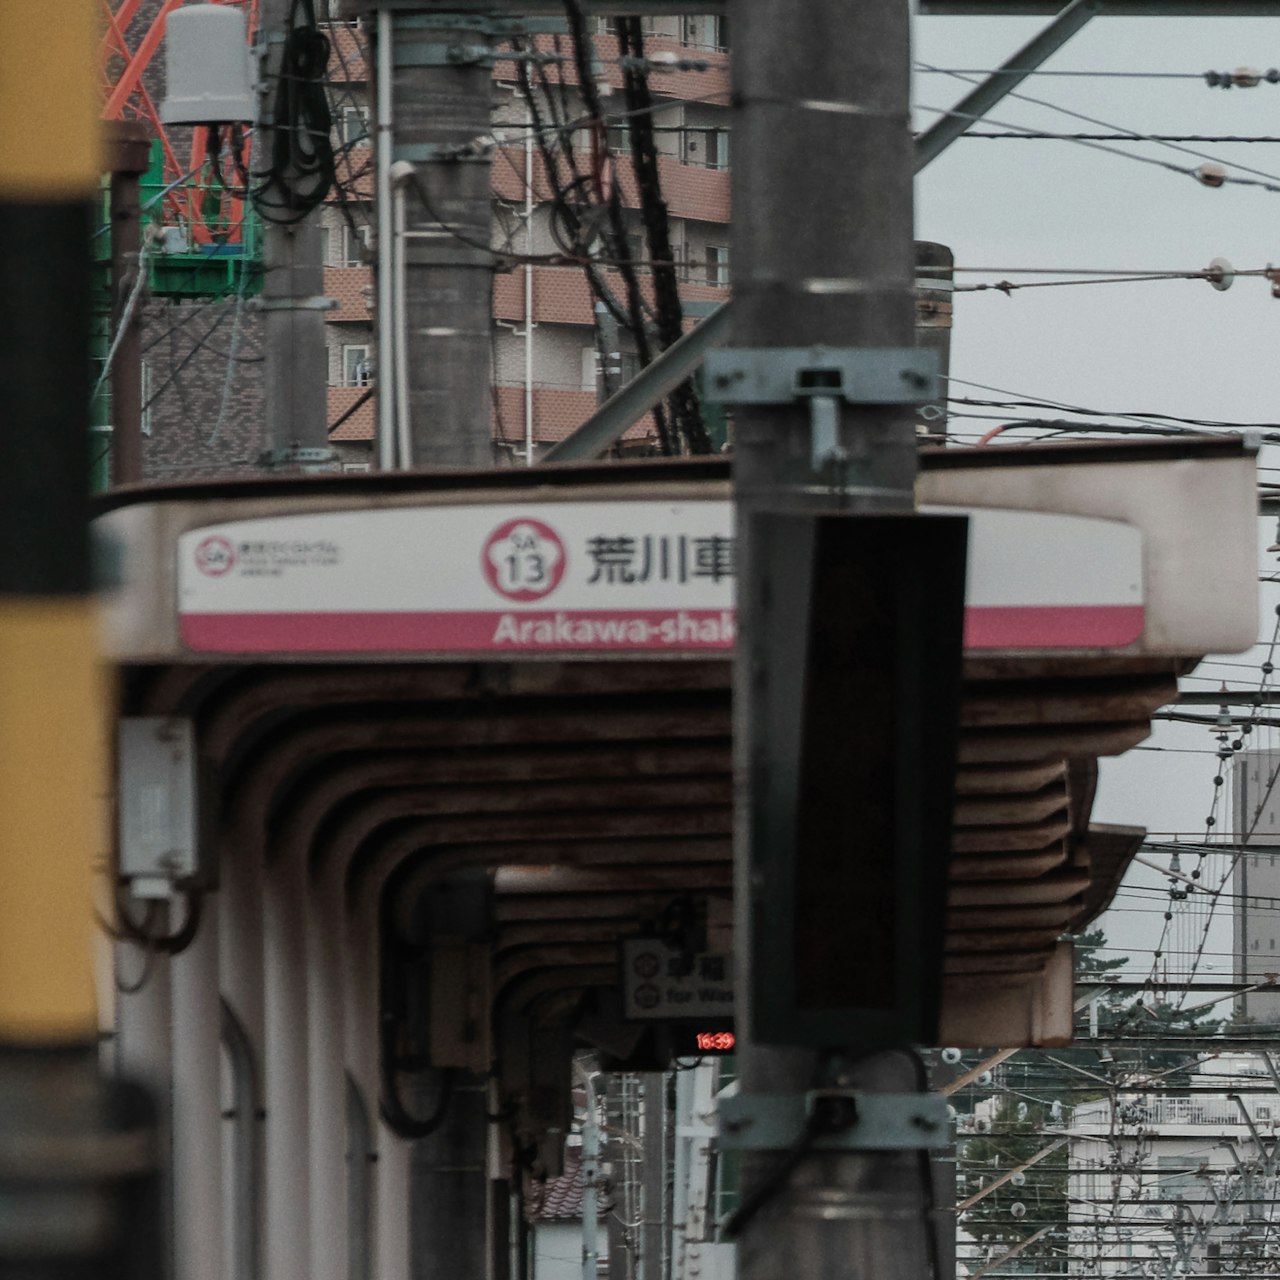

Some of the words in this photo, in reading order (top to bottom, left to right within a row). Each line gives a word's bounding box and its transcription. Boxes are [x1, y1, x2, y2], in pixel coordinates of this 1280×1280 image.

[506, 555, 544, 583] 13
[586, 535, 735, 584] 荒川車
[696, 1032, 735, 1050] 16:39
